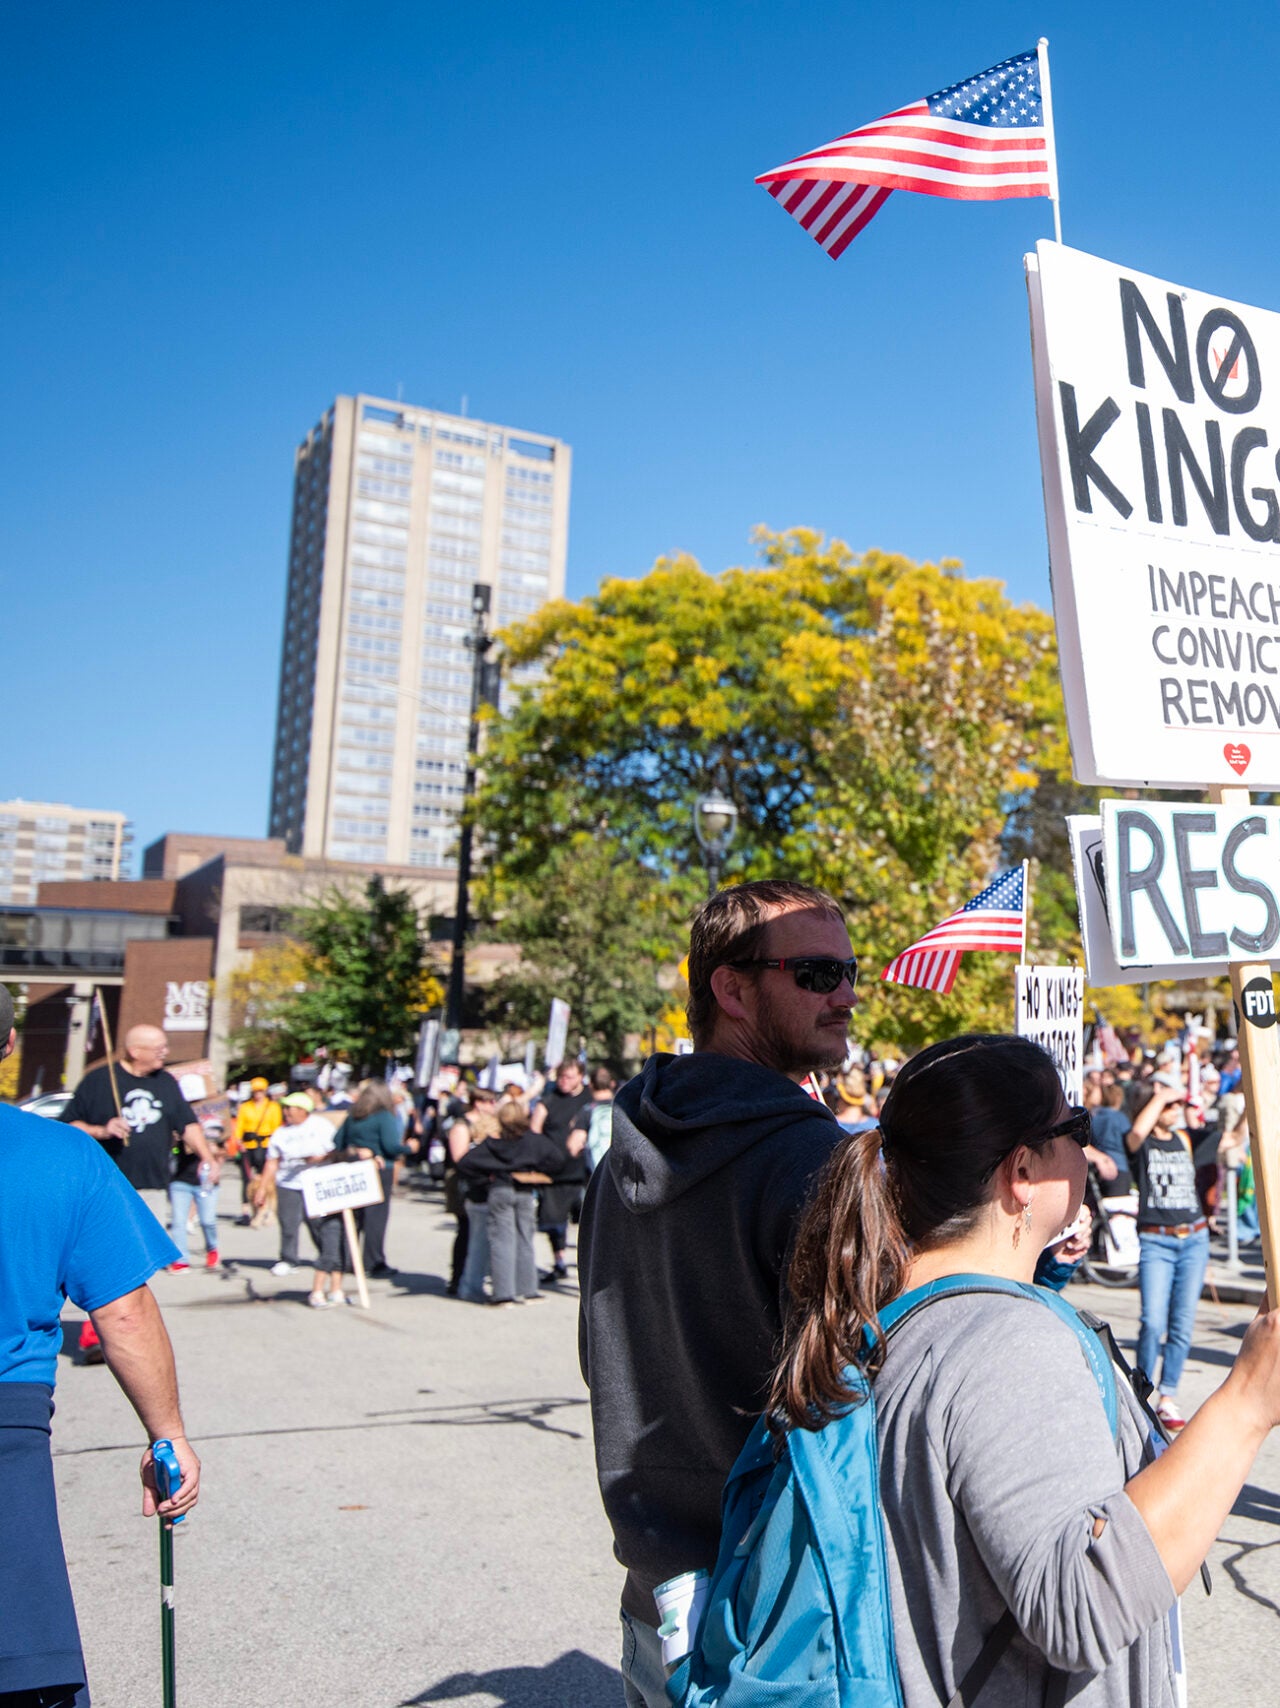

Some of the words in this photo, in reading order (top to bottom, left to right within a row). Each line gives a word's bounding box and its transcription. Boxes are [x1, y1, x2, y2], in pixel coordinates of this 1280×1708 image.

[1119, 277, 1262, 414] NO
[1244, 989, 1276, 1017] FDT
[315, 1180, 367, 1202] CHICAGO
